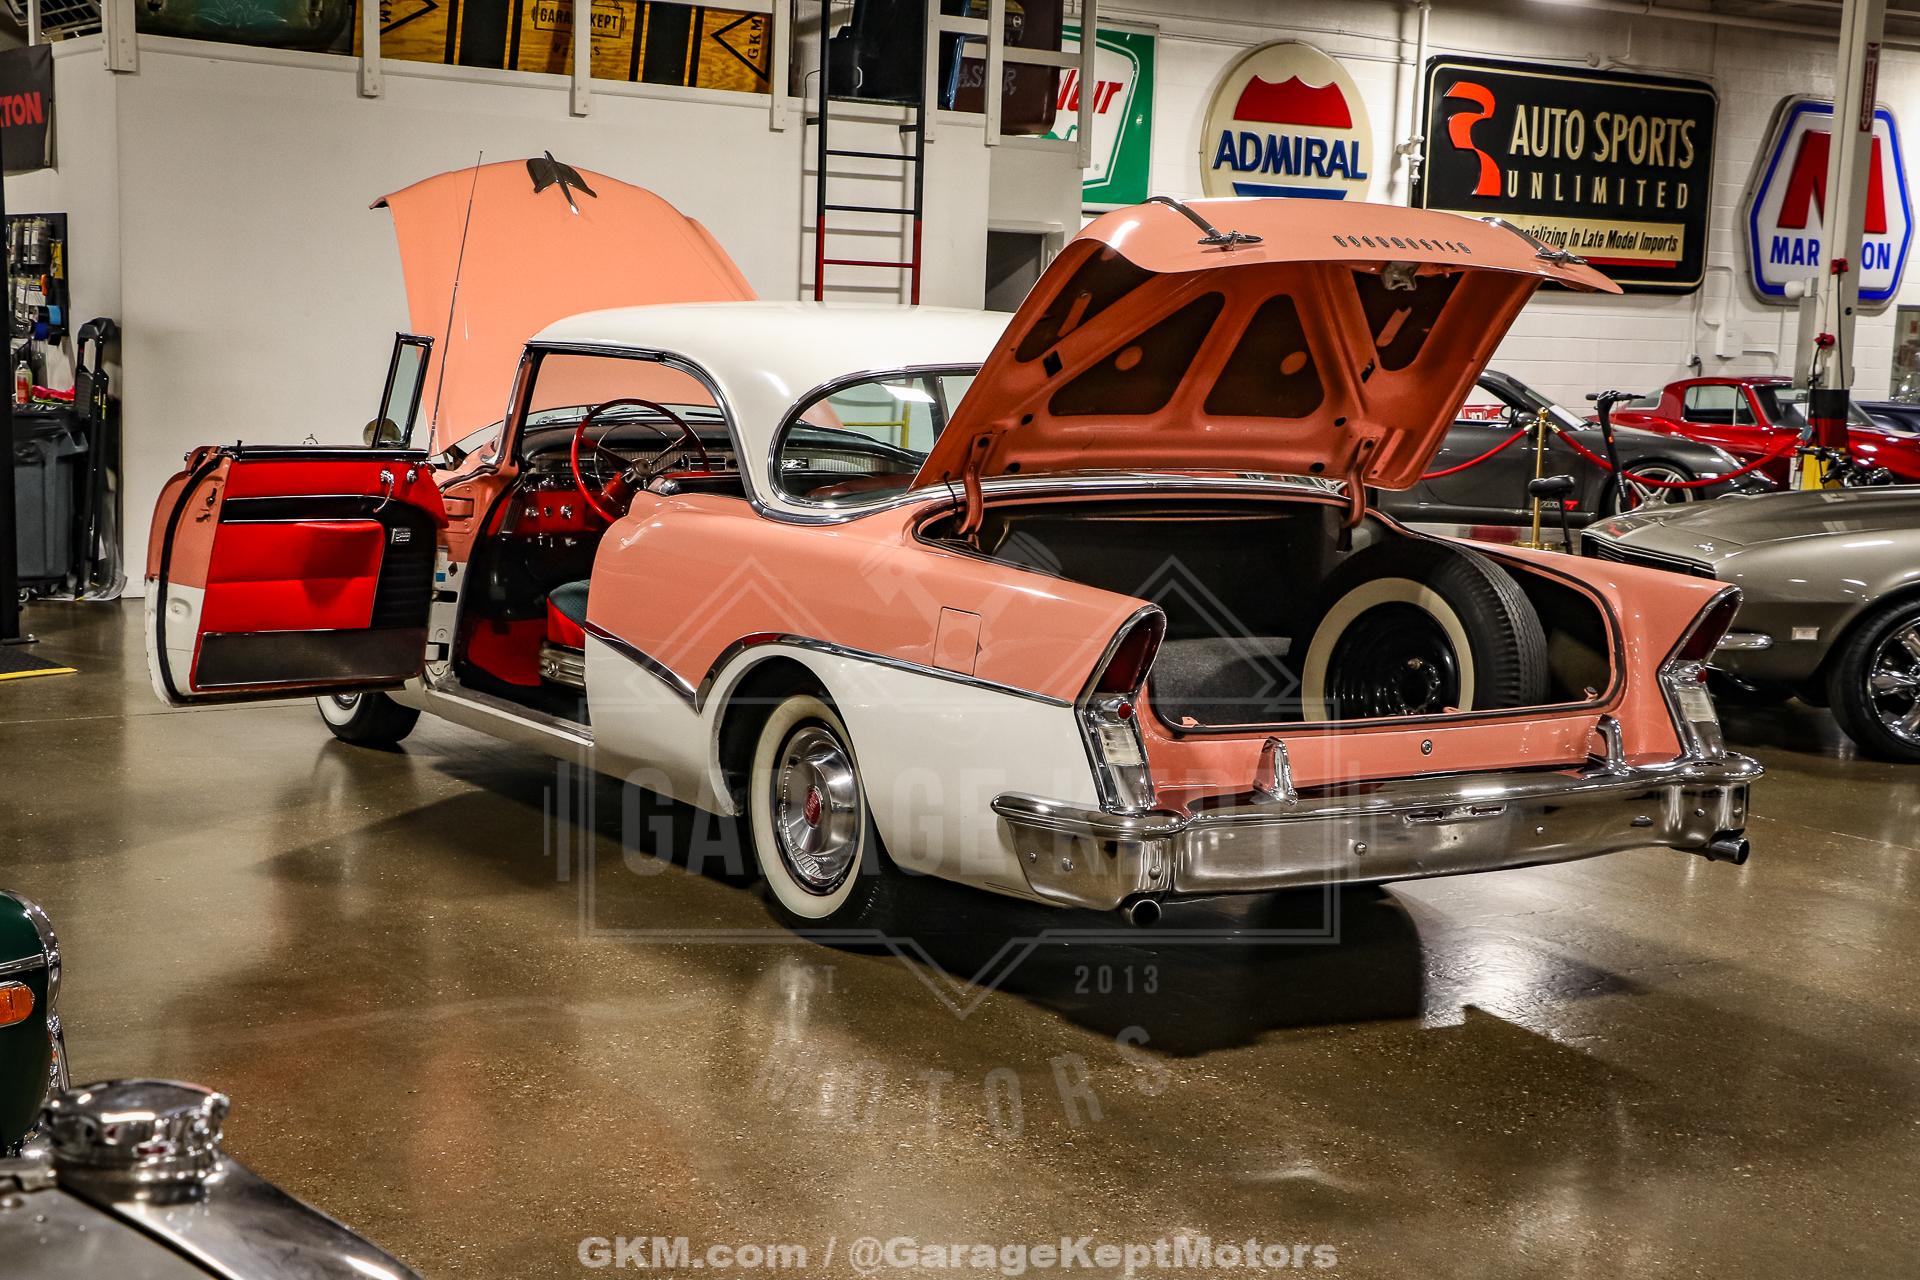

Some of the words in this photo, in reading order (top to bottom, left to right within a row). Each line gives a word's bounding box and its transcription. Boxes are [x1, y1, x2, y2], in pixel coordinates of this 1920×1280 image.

[747, 16, 764, 60] GKM
[0, 91, 44, 128] TON
[1212, 129, 1368, 180] ADMIRAL
[1509, 104, 1585, 160] AUTO
[1593, 111, 1697, 169] SPORTS
[1507, 169, 1689, 210] UNLIMITED
[1569, 227, 1580, 247] In
[1581, 229, 1604, 249] Late
[1606, 230, 1639, 251] Model
[1639, 235, 1679, 254] Imports
